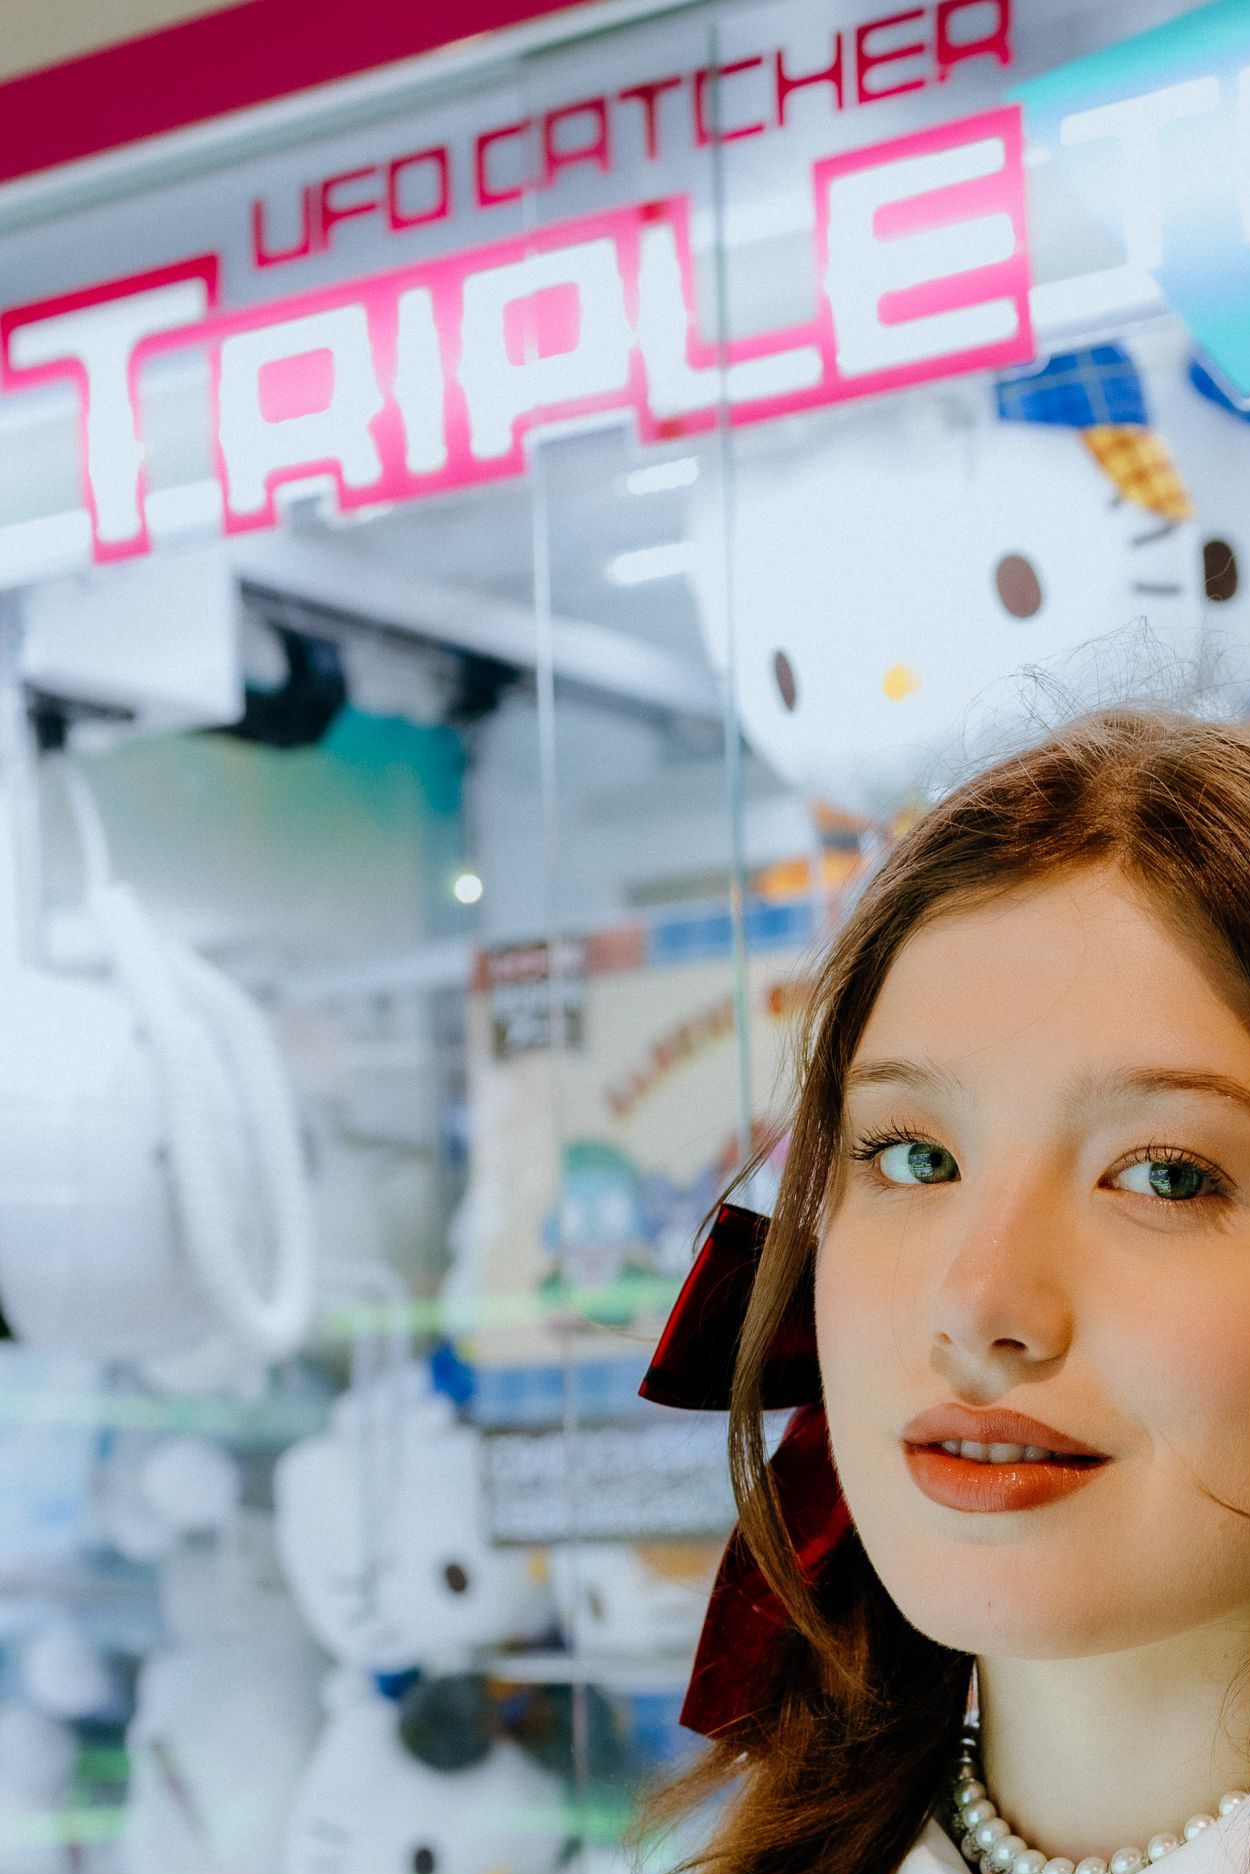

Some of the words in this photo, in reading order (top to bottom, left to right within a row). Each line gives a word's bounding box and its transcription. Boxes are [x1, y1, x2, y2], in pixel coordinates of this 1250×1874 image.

[250, 146, 450, 271] UFO
[475, 0, 1014, 210] CATCHER
[1, 112, 1030, 558] TRIPLE
